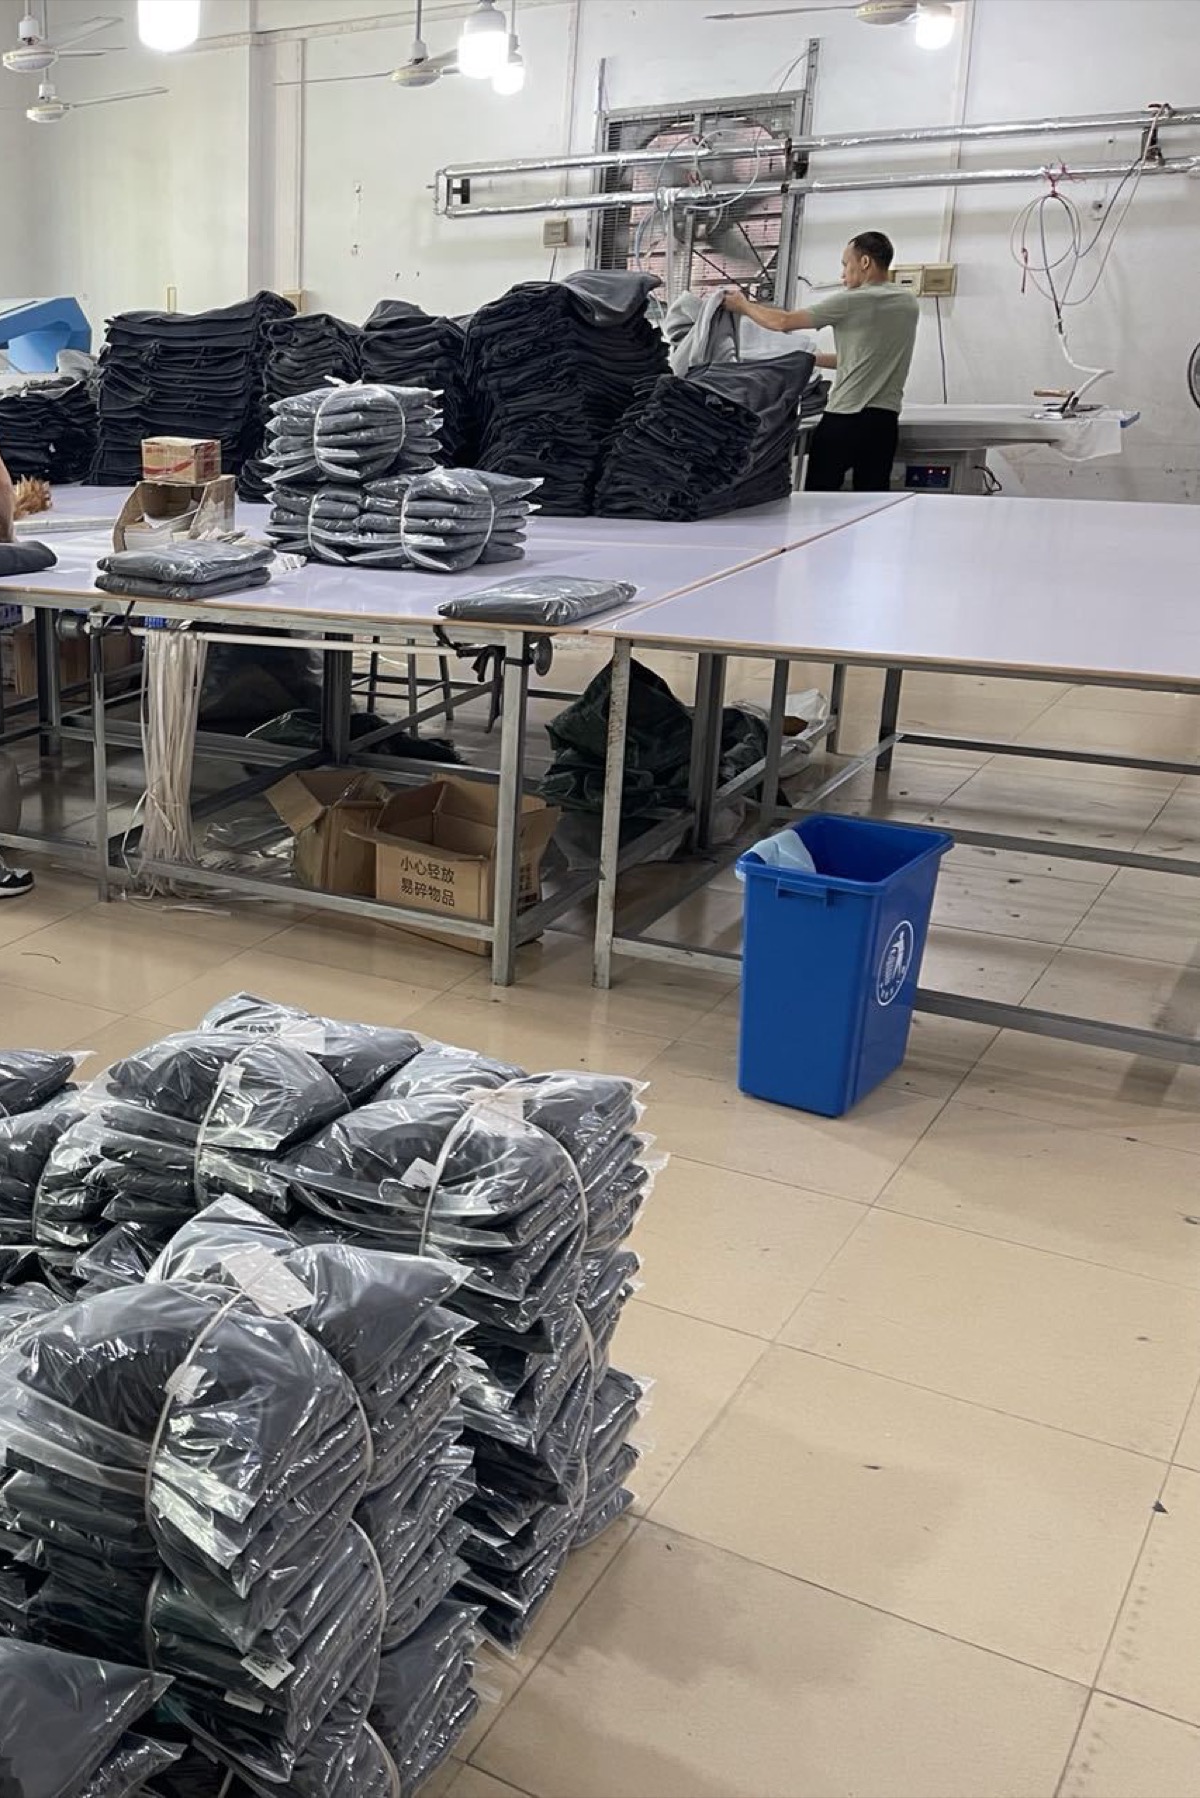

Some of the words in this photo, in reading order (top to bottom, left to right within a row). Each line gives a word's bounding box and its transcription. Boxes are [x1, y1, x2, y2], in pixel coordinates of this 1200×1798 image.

[400, 855, 455, 885] 小心轻放
[401, 877, 455, 906] 易碎物品
